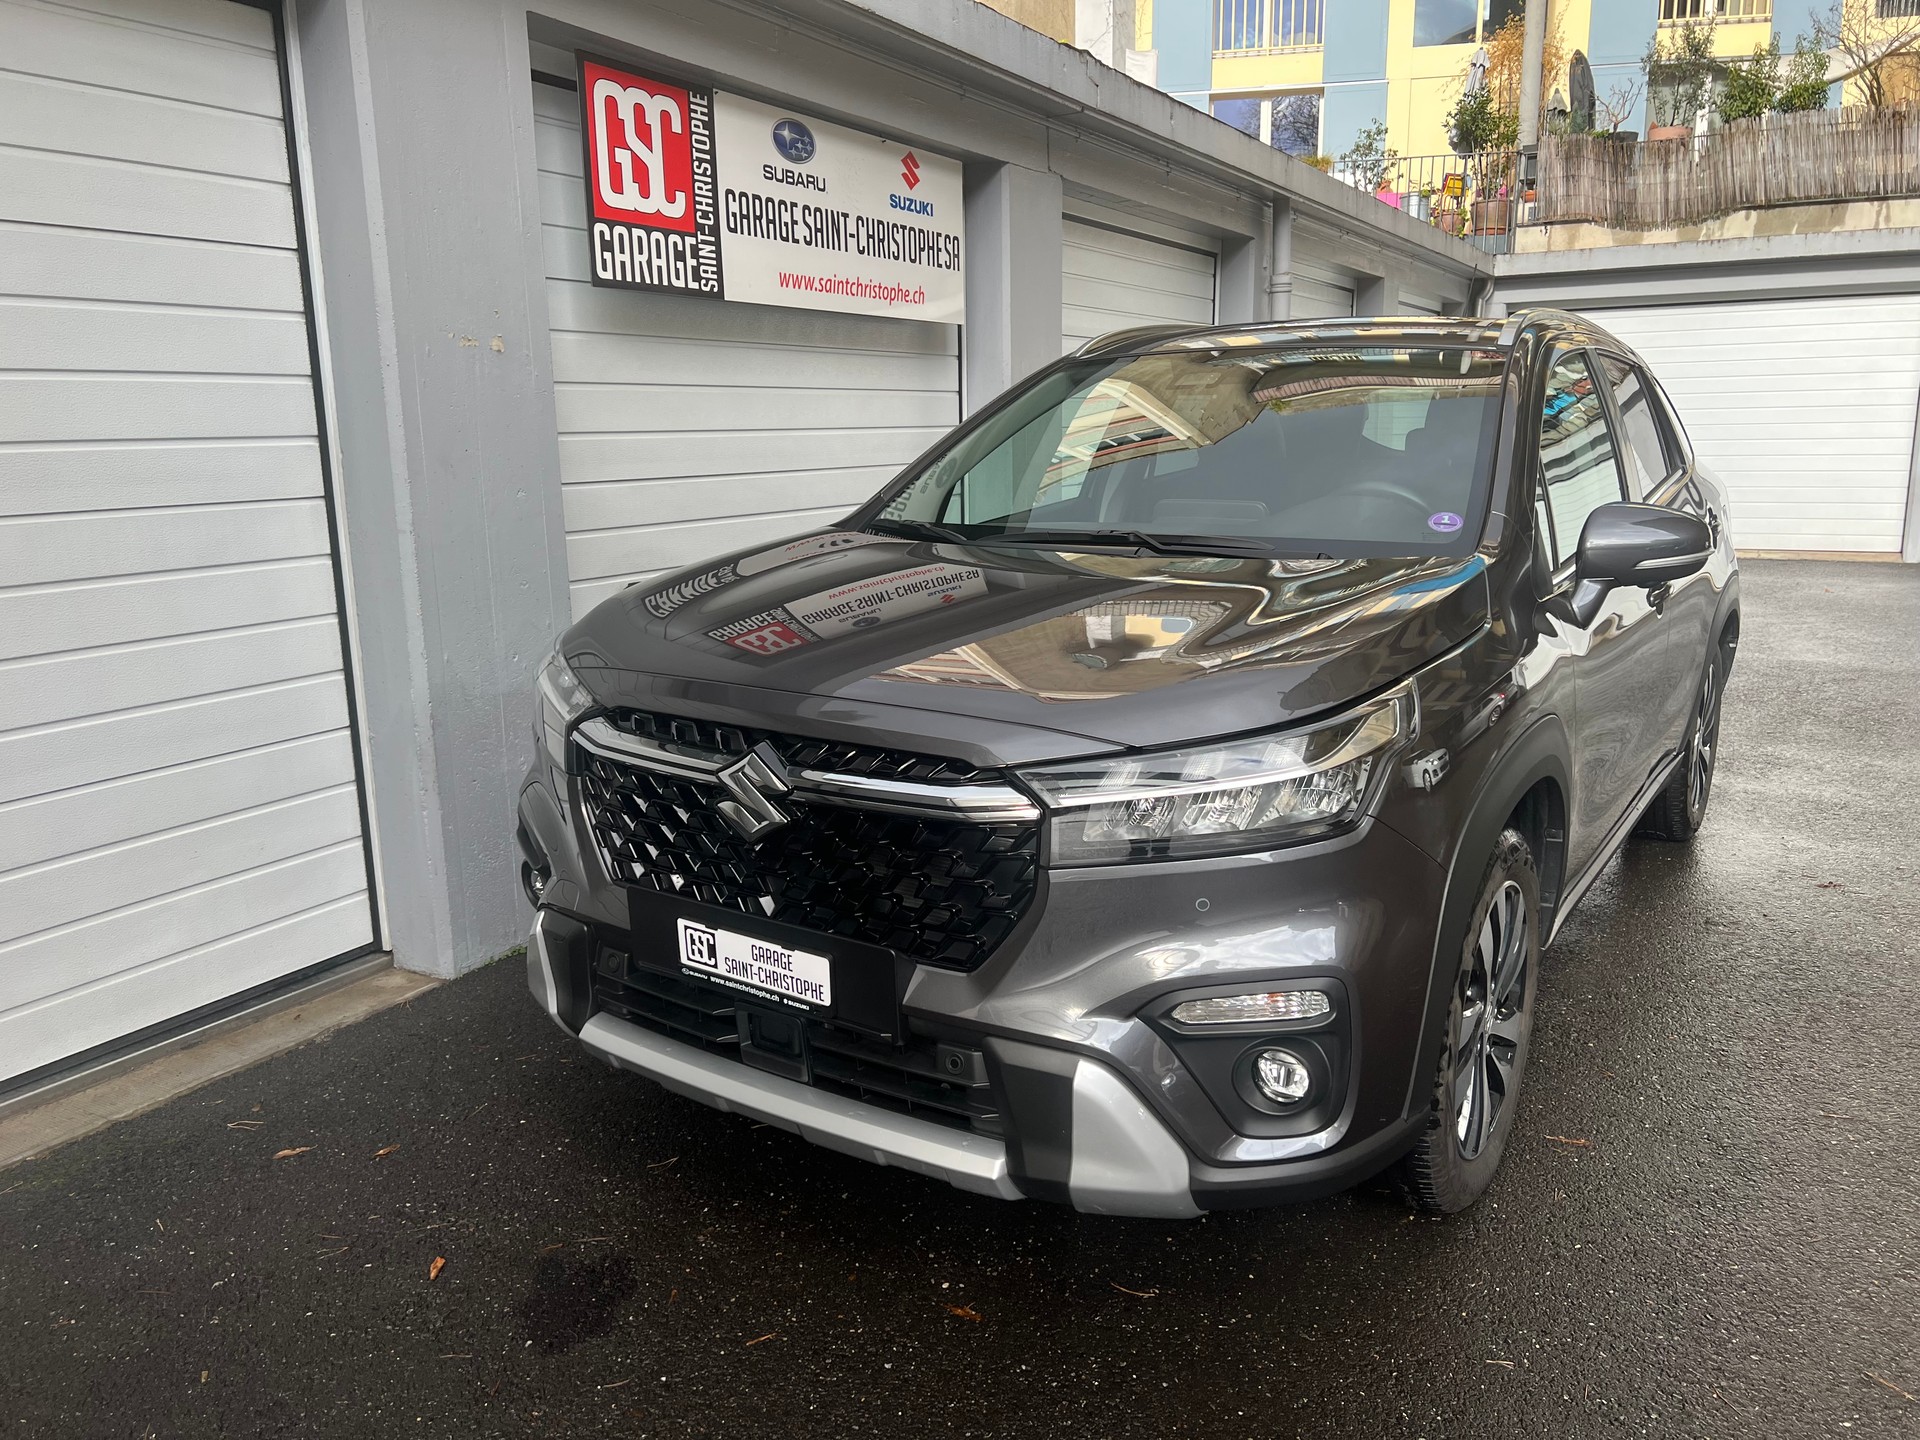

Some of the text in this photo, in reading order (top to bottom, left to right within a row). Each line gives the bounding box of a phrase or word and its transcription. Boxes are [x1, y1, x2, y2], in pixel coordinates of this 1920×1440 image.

[593, 78, 686, 218] GSC
[689, 91, 718, 293] SAINT-CHRISTOPHE
[763, 164, 826, 192] SUBARU
[889, 193, 934, 217] SUZUKI
[725, 188, 960, 272] GARAGE SAINT-CHRISTOPHE SA
[594, 222, 701, 289] GARAGE
[779, 271, 925, 306] www.saintchristophe.ch
[751, 945, 793, 972] GARAGE
[710, 976, 780, 1002] www.saintchristophe.ch
[725, 957, 824, 1001] SAINT-CHRISTOPHE
